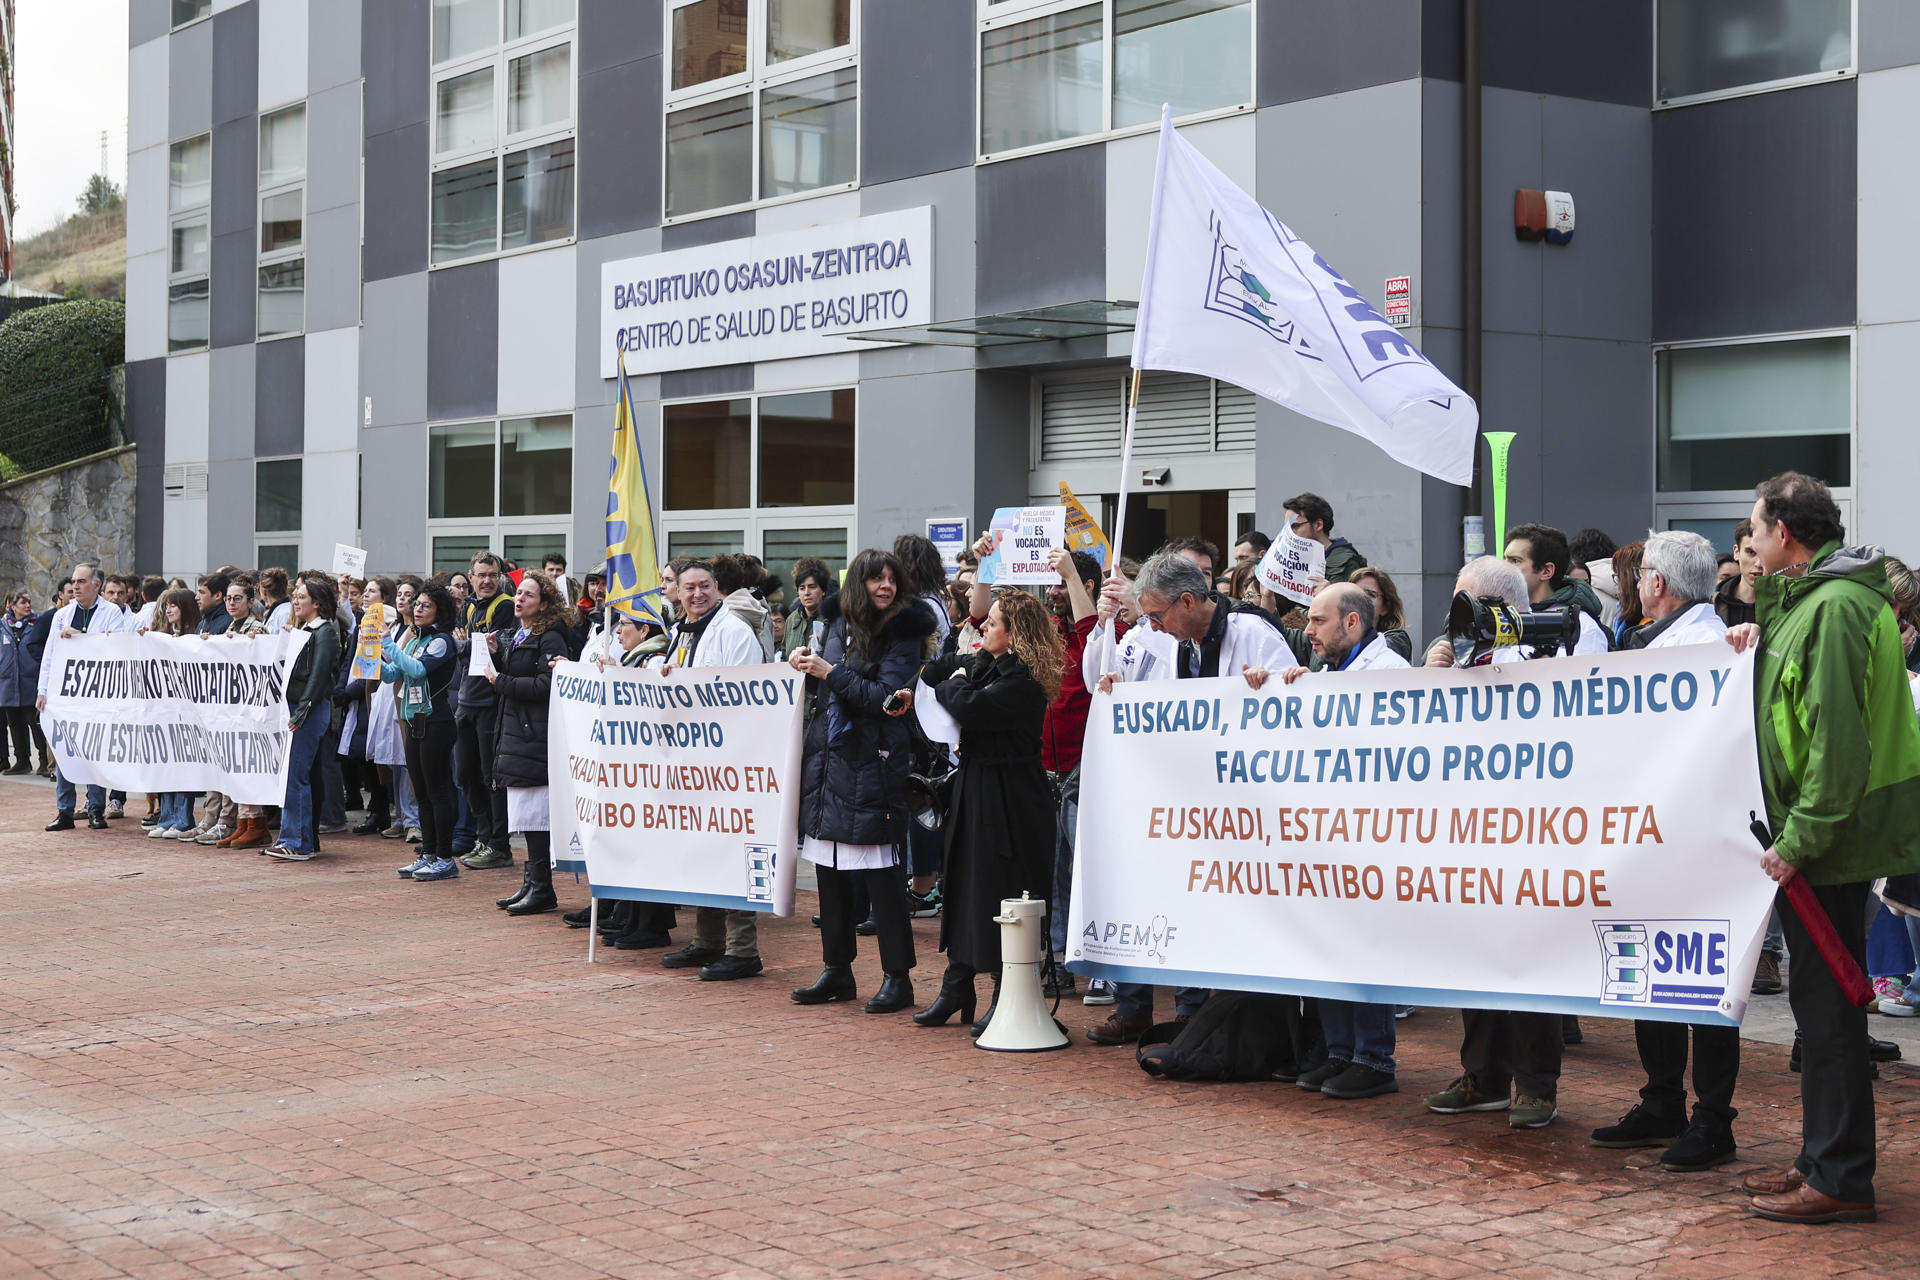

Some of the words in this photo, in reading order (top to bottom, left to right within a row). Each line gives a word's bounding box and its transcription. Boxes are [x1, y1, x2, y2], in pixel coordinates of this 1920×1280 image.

[614, 268, 720, 310] BASURTUKO
[724, 238, 911, 294] OSASUN-ZENTROA
[1387, 279, 1409, 293] ABRA
[616, 319, 683, 352] CENTRO
[688, 316, 711, 343] DE
[715, 307, 775, 340] SALUD
[780, 302, 806, 332] DE
[811, 288, 908, 329] BASURTO
[1015, 535, 1052, 549] VOCACIÓN,
[1023, 526, 1033, 536] NO
[1034, 525, 1044, 536] ES
[1030, 550, 1040, 561] ES
[1289, 549, 1300, 561] ES
[1283, 568, 1294, 581] ES
[60, 659, 128, 699] ESTATUTU
[614, 680, 693, 710] ESTATUTO
[694, 675, 779, 708] MÉDICO
[781, 678, 796, 706] Y
[1113, 698, 1230, 737] EUSKADI,
[1239, 696, 1303, 731] POR
[1312, 692, 1362, 728] UN
[1370, 681, 1542, 726] ESTATUTO
[1552, 667, 1699, 719] MÉDICO
[1709, 667, 1732, 706] Y
[52, 719, 84, 758] POR
[82, 722, 107, 762] UN
[107, 722, 168, 764] ESTATUTO
[653, 721, 724, 748] PROPIO
[666, 764, 740, 793] MEDIKO
[743, 765, 781, 794] ETA
[1215, 746, 1431, 784] FACULTATIVO
[1441, 740, 1574, 782] PROPIO
[643, 803, 702, 832] BATEN
[706, 806, 756, 836] ALDE
[1147, 806, 1272, 847] EUSKADI,
[1279, 807, 1438, 844] ESTATUTU
[1448, 806, 1589, 846] MEDIKO
[1599, 804, 1664, 845] ETA
[1187, 859, 1384, 901] FAKULTATIBO
[1395, 864, 1504, 906] BATEN
[1514, 868, 1613, 908] ALDE
[1652, 930, 1727, 976] SME
